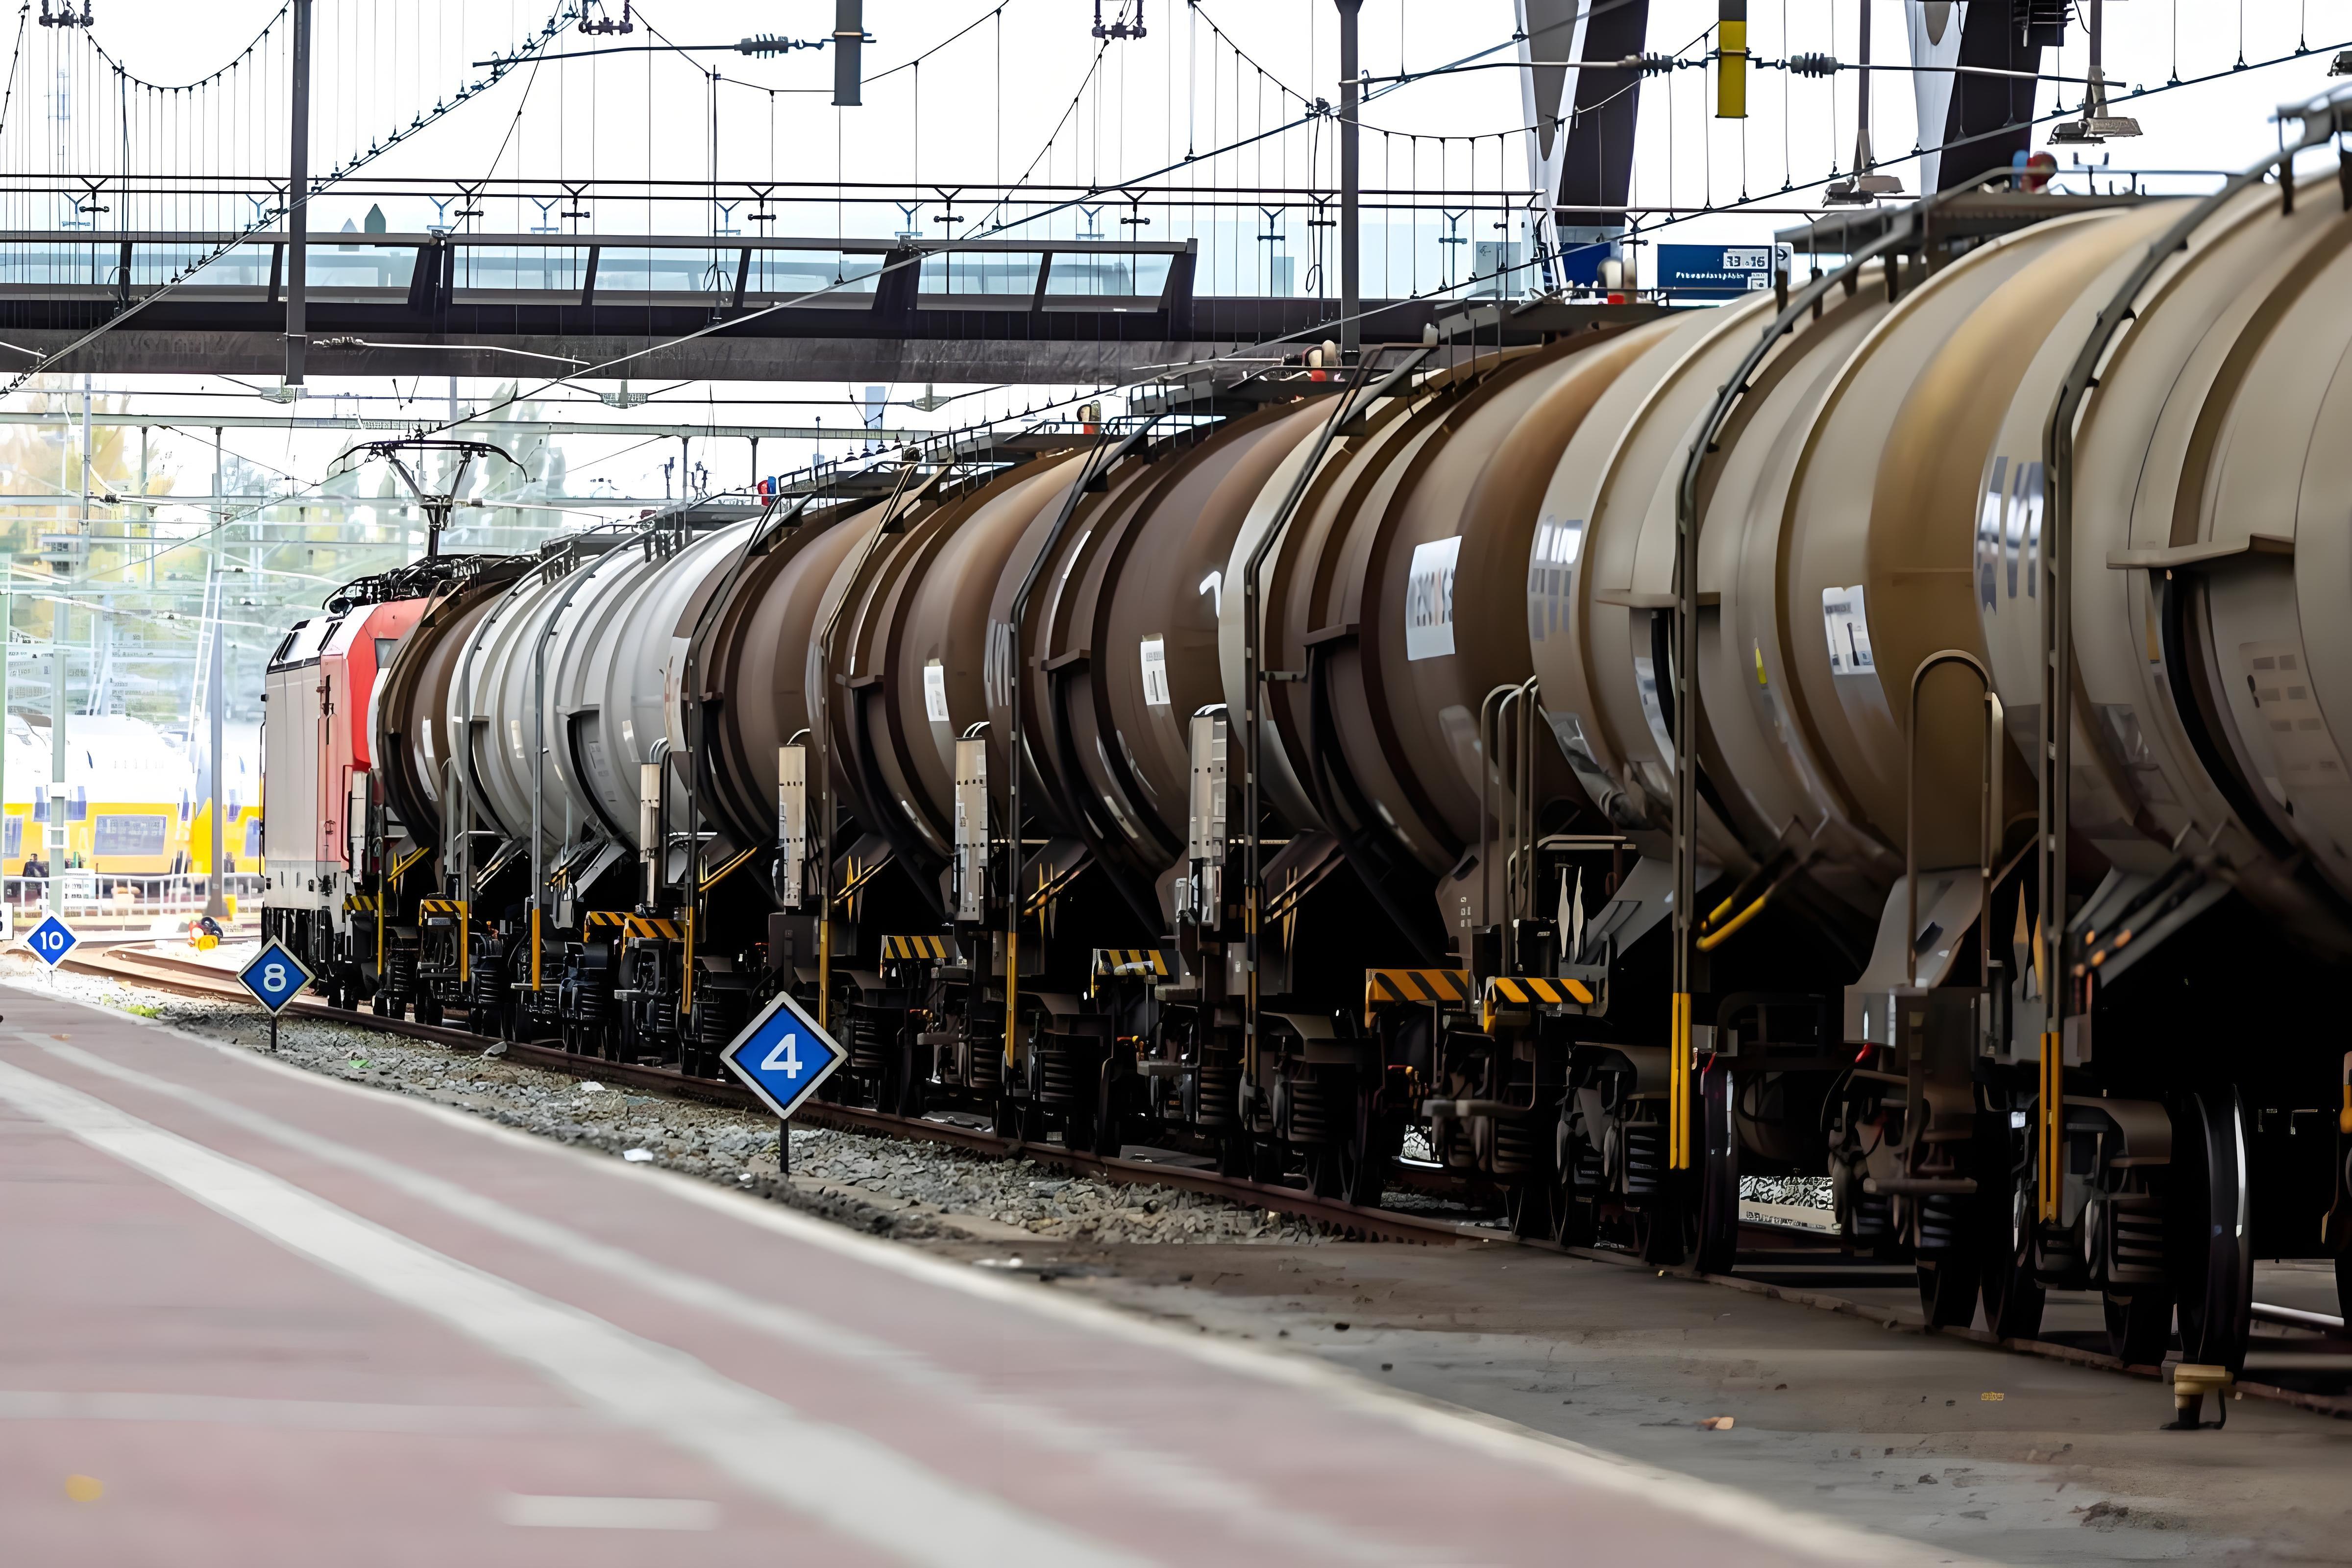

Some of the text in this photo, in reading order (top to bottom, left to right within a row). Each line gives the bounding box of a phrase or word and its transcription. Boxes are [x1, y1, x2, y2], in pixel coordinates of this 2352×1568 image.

[40, 931, 64, 950] 10
[263, 963, 287, 992] 8
[760, 1033, 803, 1079] 4
